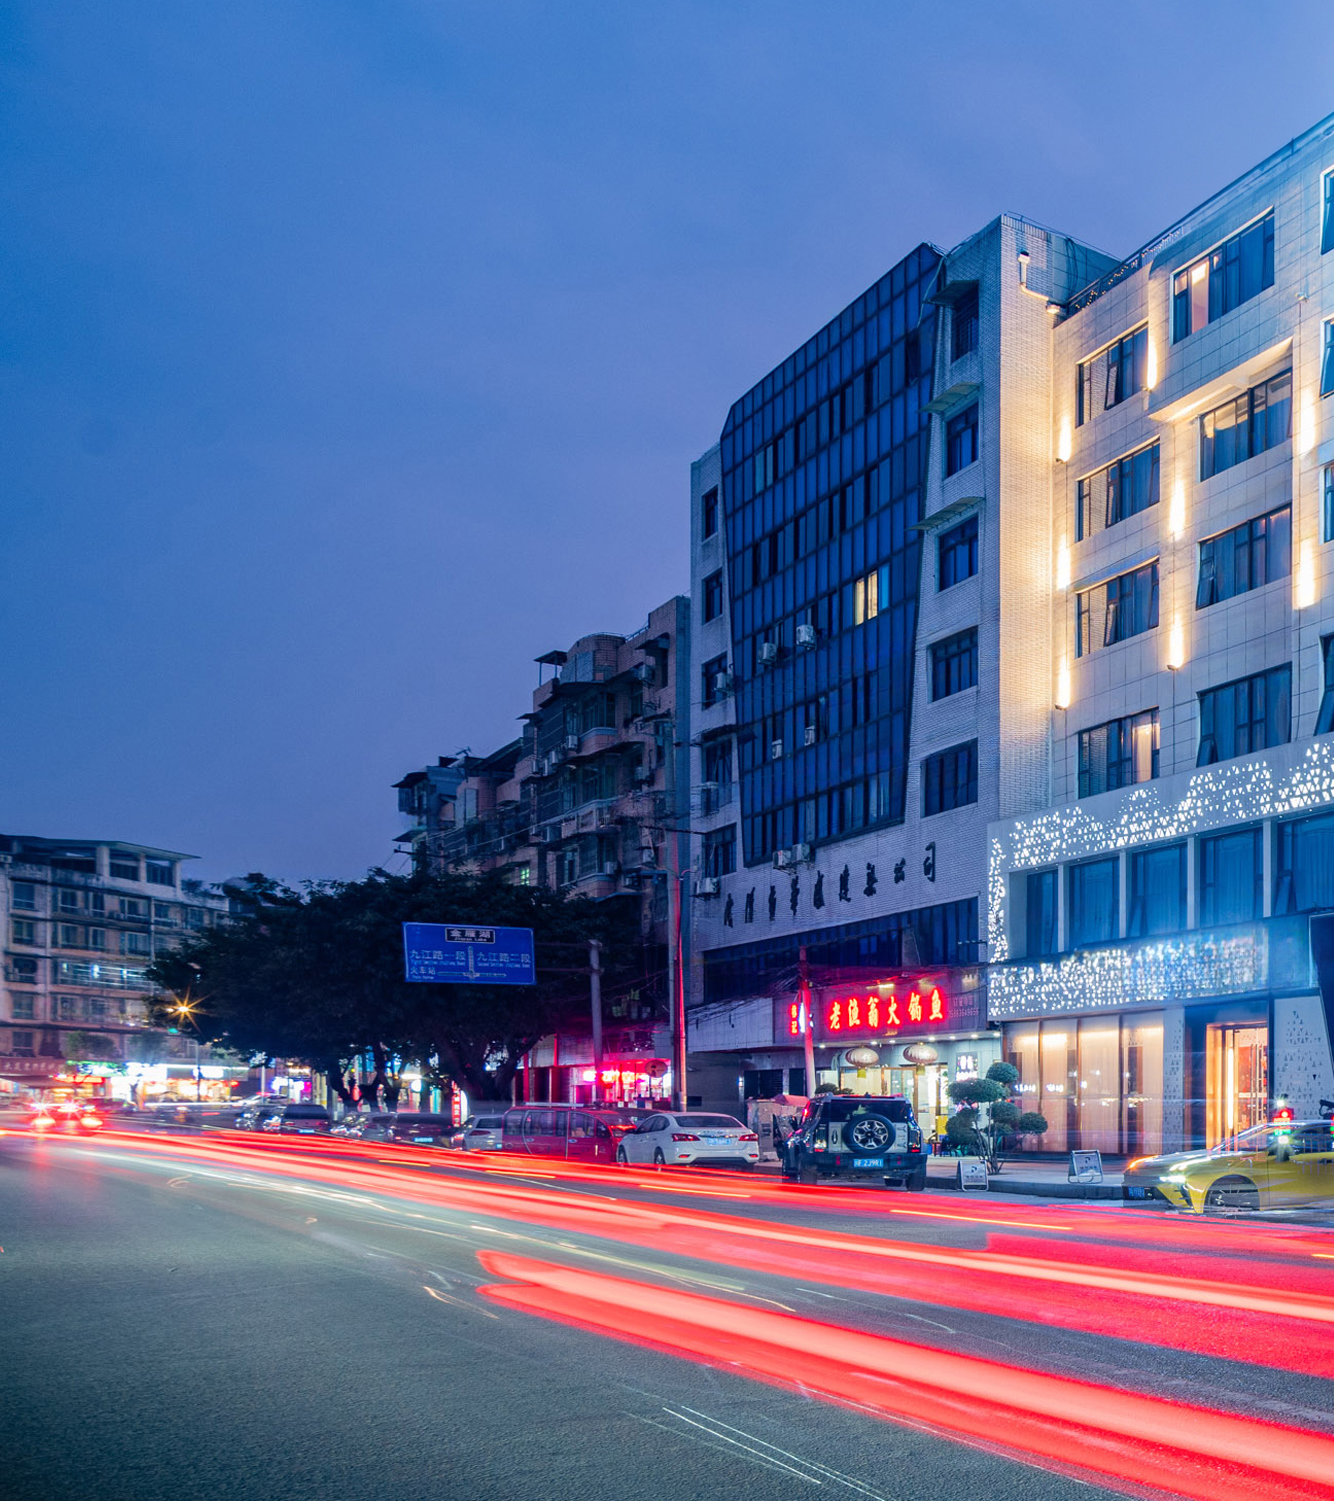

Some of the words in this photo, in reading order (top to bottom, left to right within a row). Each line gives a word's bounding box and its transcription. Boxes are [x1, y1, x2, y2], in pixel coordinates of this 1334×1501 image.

[410, 949, 467, 960] 九江路一段
[477, 952, 532, 964] 九江路二段
[410, 966, 436, 976] 火车站
